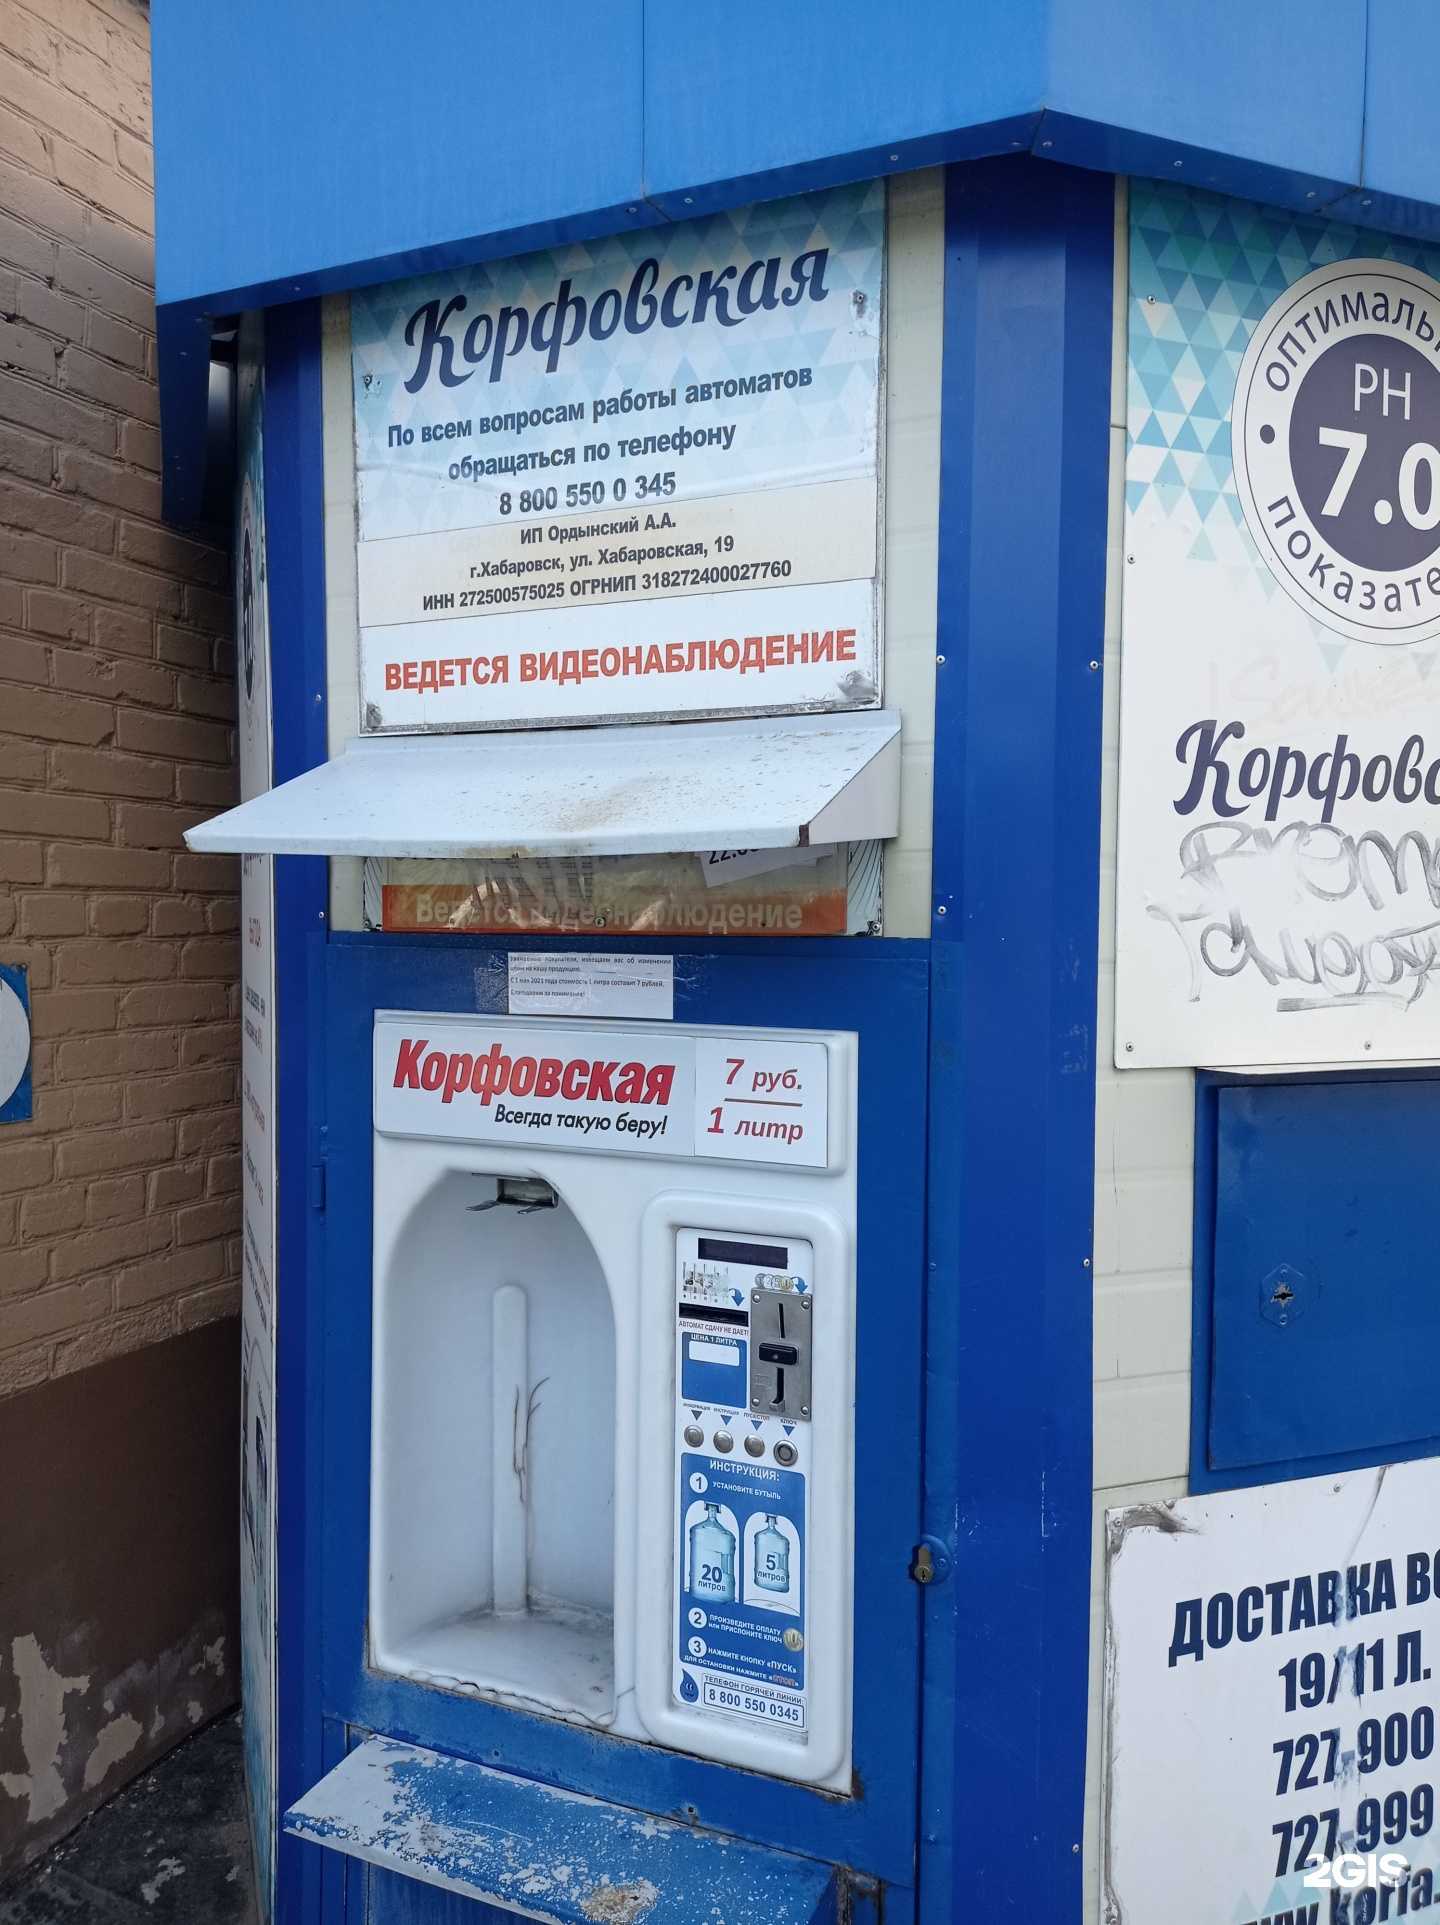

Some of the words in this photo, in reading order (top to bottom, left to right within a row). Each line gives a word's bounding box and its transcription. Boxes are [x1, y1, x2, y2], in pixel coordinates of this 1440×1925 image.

[404, 248, 830, 394] Корфовская
[1265, 291, 1440, 391] оптималь
[388, 425, 414, 448] По
[421, 419, 472, 444] всем
[479, 402, 584, 436] вопросам
[593, 385, 677, 424] работы
[685, 367, 813, 403] автоматов
[448, 446, 576, 483] обращаться
[583, 440, 610, 464] по
[617, 424, 737, 459] телефону
[500, 491, 512, 515] 8
[519, 487, 558, 514] 800
[565, 482, 604, 509] 550
[613, 477, 626, 502] 0
[634, 471, 677, 498] 345
[1318, 426, 1440, 531] 7.0
[520, 527, 543, 545] ИП
[548, 517, 639, 545] Ордынский
[644, 512, 676, 530] А.А.
[470, 555, 565, 580] г.Хабаровск,
[569, 551, 593, 573] ул.
[598, 540, 709, 566] Хабаровская,
[714, 535, 734, 553] 19
[423, 593, 454, 611] ИНН
[459, 581, 565, 608] 272500575025
[570, 574, 636, 597] ОГРНИП
[641, 559, 792, 590] 318272400027760
[384, 655, 509, 695] ВЕДЕТСЯ
[520, 628, 857, 686] ВИДЕОНАБЛЮДЕНИЕ
[392, 1038, 676, 1107] Корфовская
[725, 1058, 745, 1085] 7
[751, 1069, 802, 1093] руб.
[494, 1103, 552, 1129] Всегда
[556, 1114, 611, 1134] такую
[615, 1113, 668, 1139] беру!
[706, 1106, 725, 1134] 1
[733, 1119, 804, 1145] литр
[679, 1320, 704, 1330] АВТОМАТ
[704, 1324, 723, 1333] СДАЧУ
[691, 1333, 709, 1341] ЦЕНА
[715, 1336, 737, 1346] ЛИТРА
[695, 1476, 702, 1490] 1
[713, 1481, 753, 1494] УСТАНОВИТЕ
[710, 1459, 780, 1482] ИНСТРУКЦИЯ:
[701, 1563, 723, 1584] 20
[757, 1570, 786, 1583] литров
[766, 1554, 776, 1571] 5
[697, 1580, 726, 1592] литров
[693, 1611, 701, 1625] 2
[709, 1614, 755, 1630] ПРОИЗВЕДИТЕ
[755, 1624, 781, 1636] ОПЛАТУ
[1167, 1558, 1397, 1668] ДОСТАВКА
[1406, 1549, 1440, 1606] В
[720, 1624, 762, 1640] ПРИСЛОНИТЕ
[763, 1634, 782, 1644] КЛЮЧ
[693, 1640, 701, 1654] 3
[708, 1647, 739, 1660] НАЖМИТЕ
[740, 1656, 766, 1666] КНОПКУ
[698, 1658, 735, 1672] ОСТАНОВКИ
[736, 1667, 767, 1680] НАЖМИТЕ
[1394, 1630, 1432, 1687] Л.
[704, 1674, 740, 1689] ТЕЛЕФОН
[740, 1684, 775, 1698] ГОРЯЧЕЙ
[709, 1689, 716, 1700] 8
[720, 1691, 740, 1706] 800
[745, 1697, 766, 1713] 550
[769, 1704, 799, 1721] 0345
